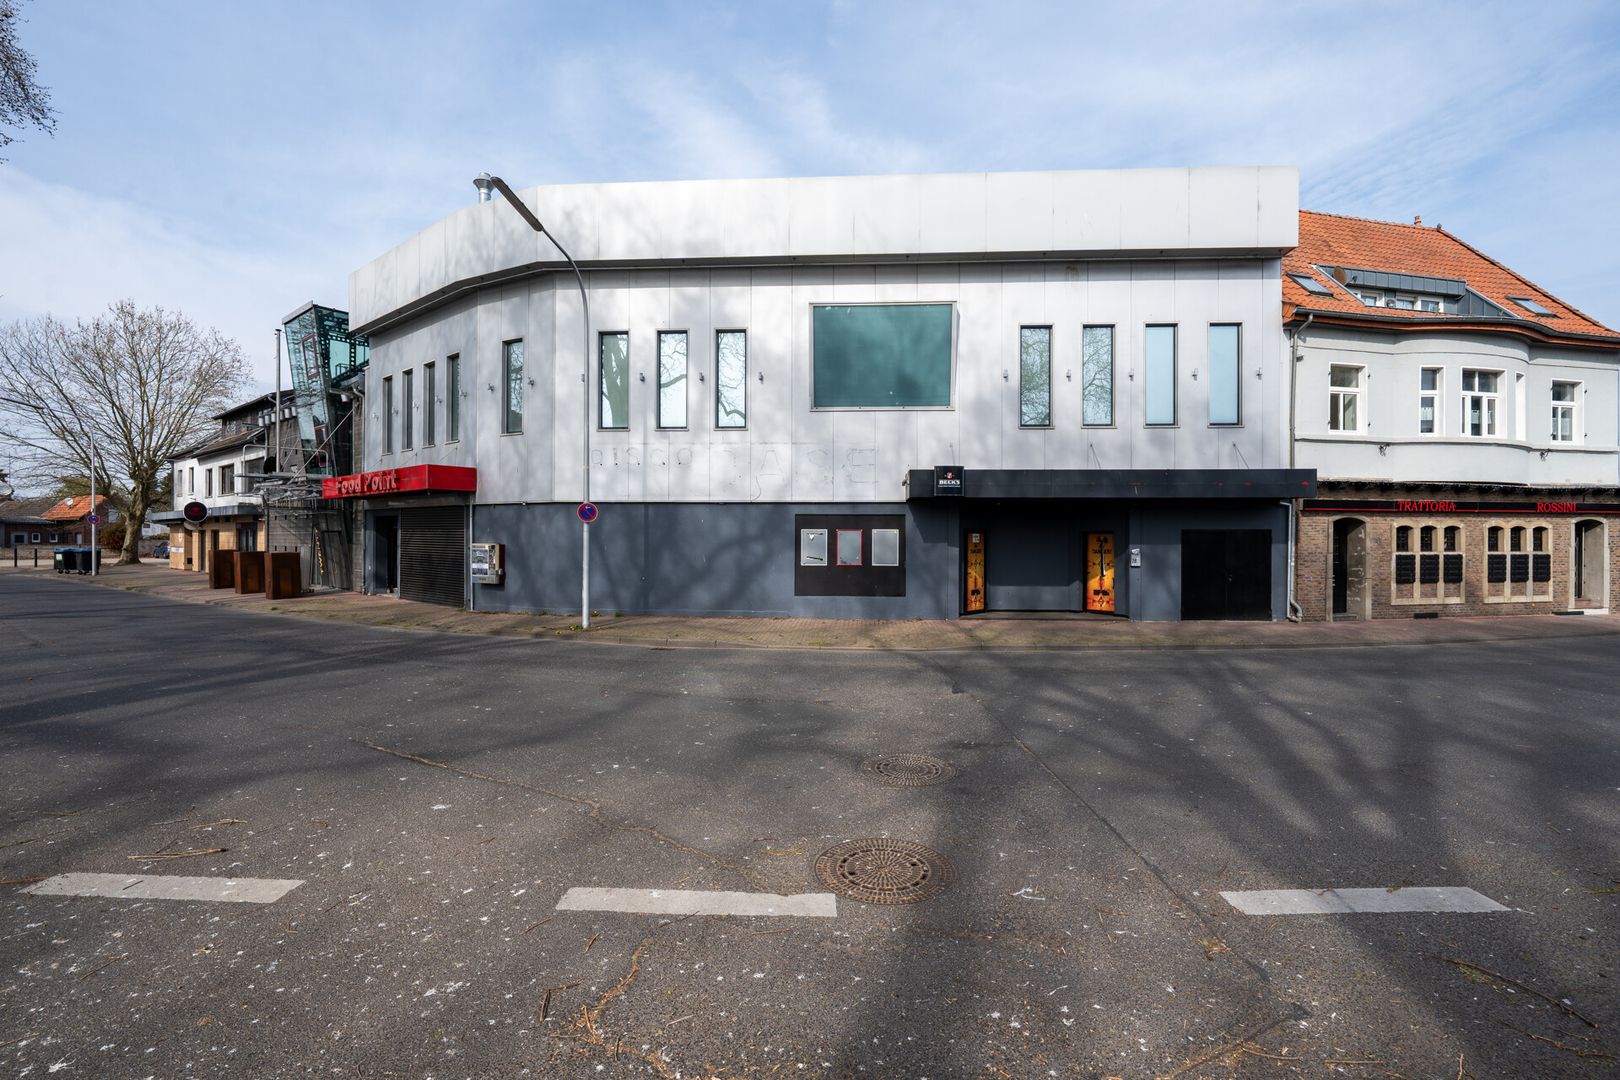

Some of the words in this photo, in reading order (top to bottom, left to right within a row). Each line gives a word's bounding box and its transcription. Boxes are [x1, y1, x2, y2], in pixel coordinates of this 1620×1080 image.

[336, 473, 362, 494] Food
[364, 469, 398, 492] Point
[1397, 500, 1456, 512] TRATTORIA
[1536, 502, 1577, 513] ROSSINI
